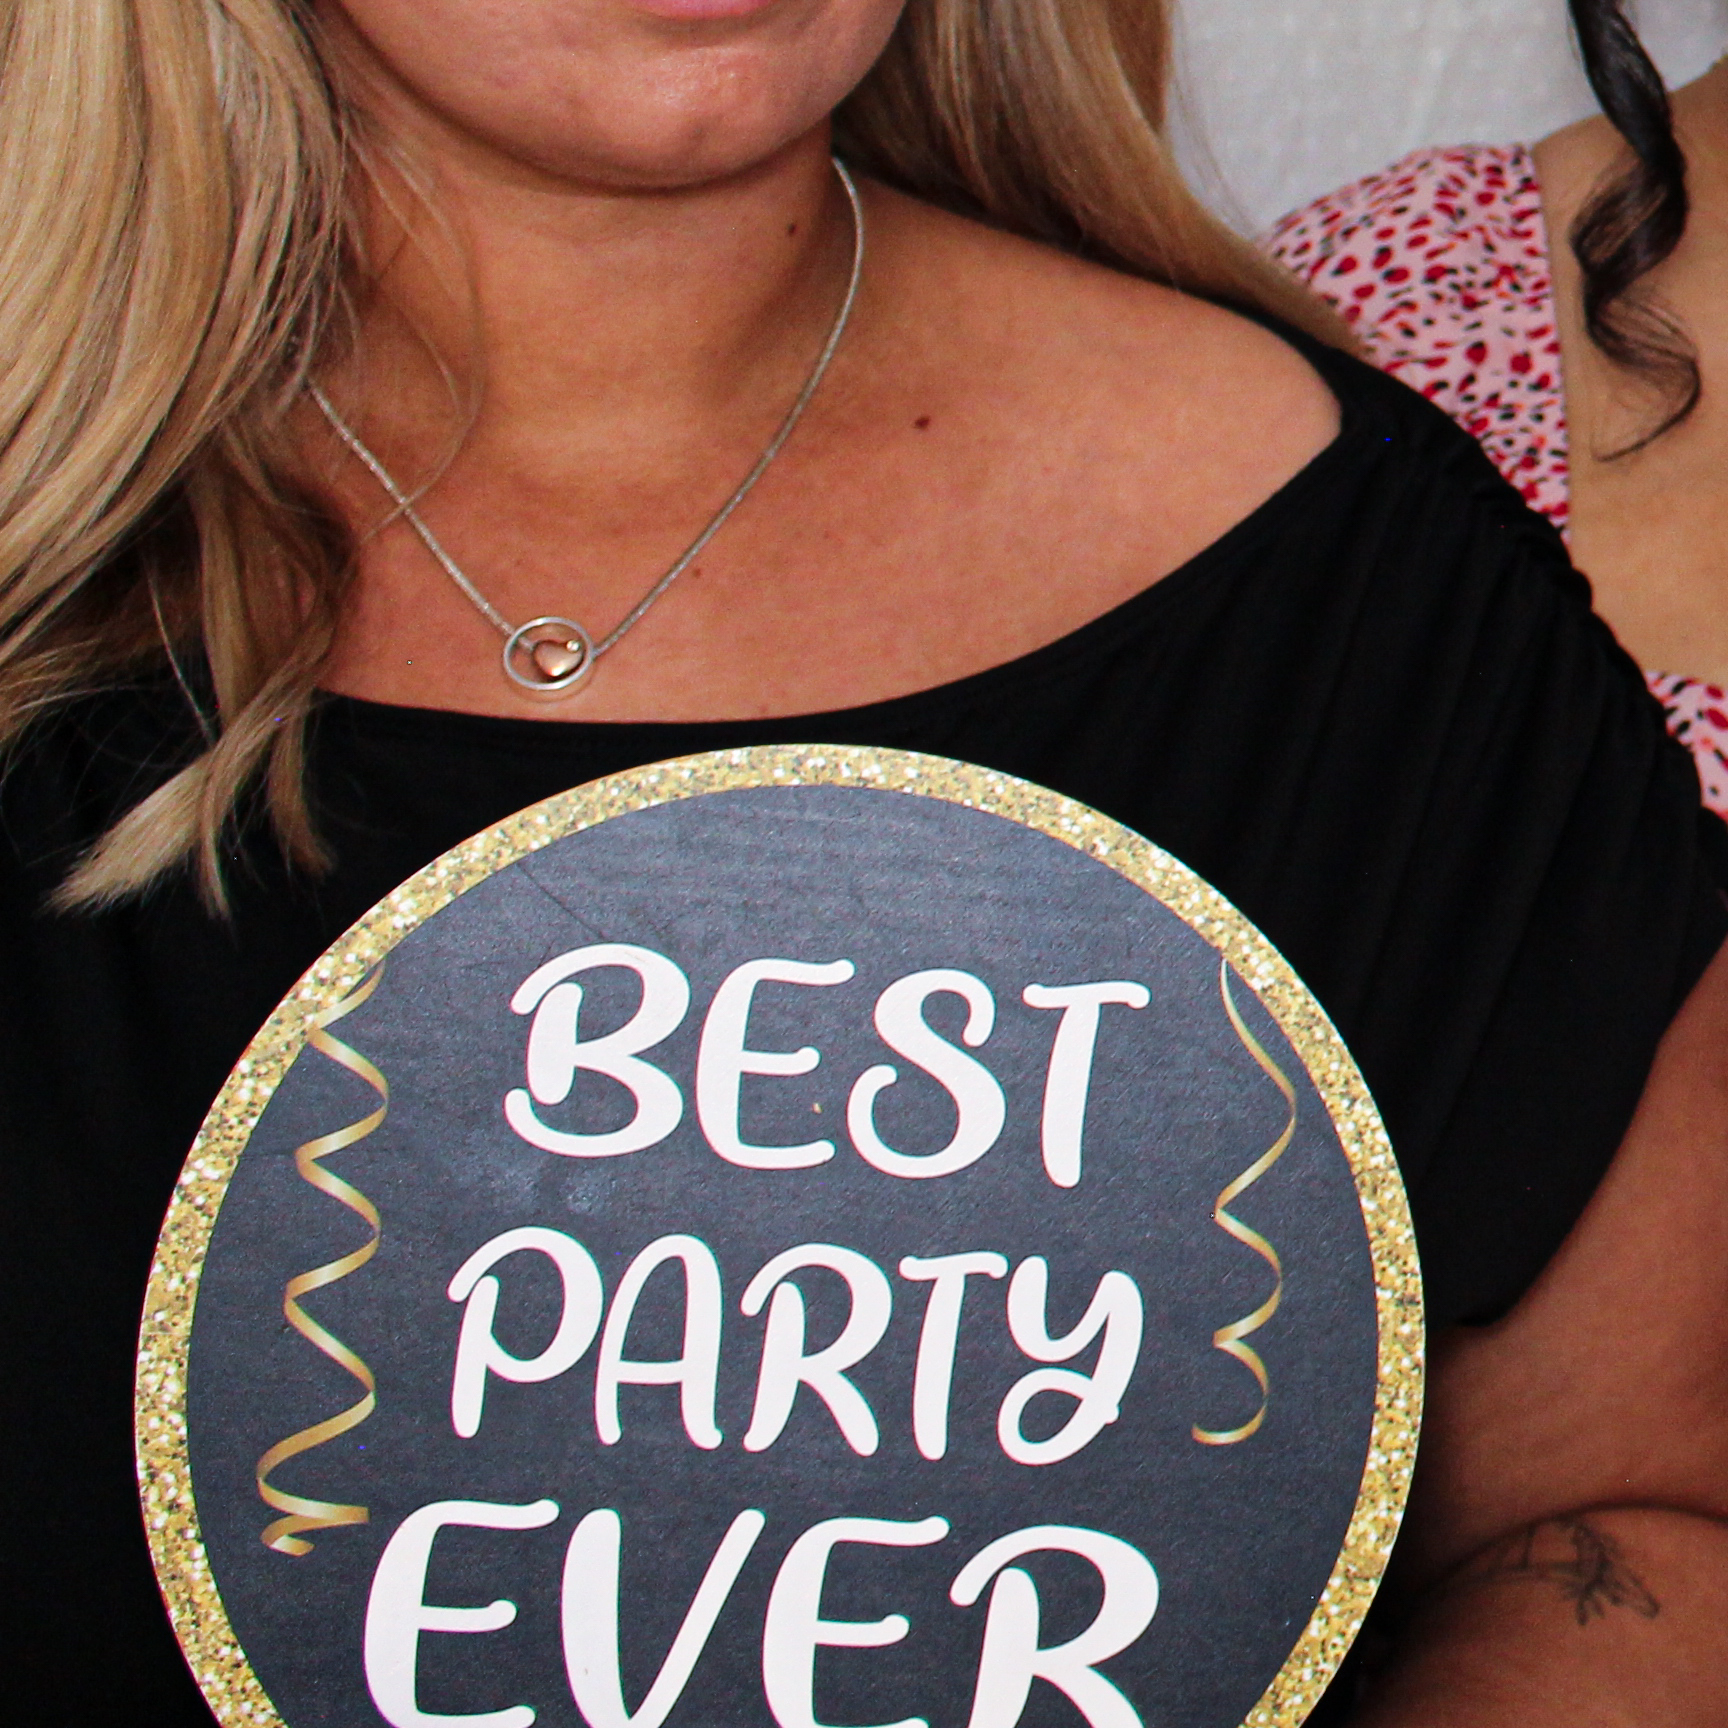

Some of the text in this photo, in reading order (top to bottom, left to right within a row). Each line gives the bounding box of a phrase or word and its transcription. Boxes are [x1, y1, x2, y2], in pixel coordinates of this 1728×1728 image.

[504, 943, 1151, 1188] BEST
[446, 1226, 1144, 1466] PARTY
[363, 1499, 1161, 1728] EVER
